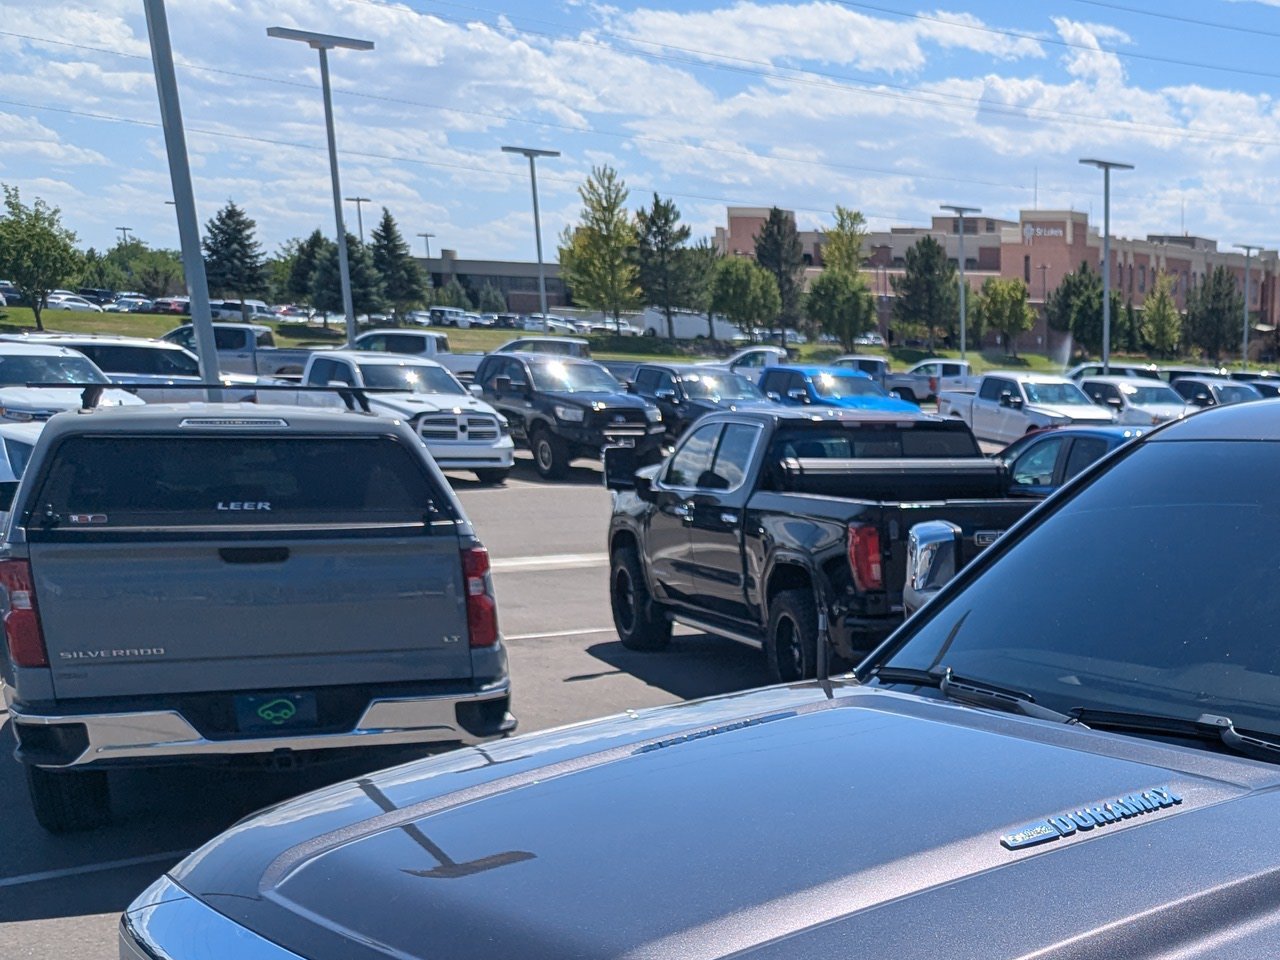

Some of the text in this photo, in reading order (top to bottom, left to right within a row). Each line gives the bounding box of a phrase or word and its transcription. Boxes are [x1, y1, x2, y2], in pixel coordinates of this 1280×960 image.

[217, 502, 271, 511] LEER
[442, 635, 461, 643] LT
[60, 648, 165, 659] SILVERADO
[1052, 785, 1183, 837] DURAMAX
